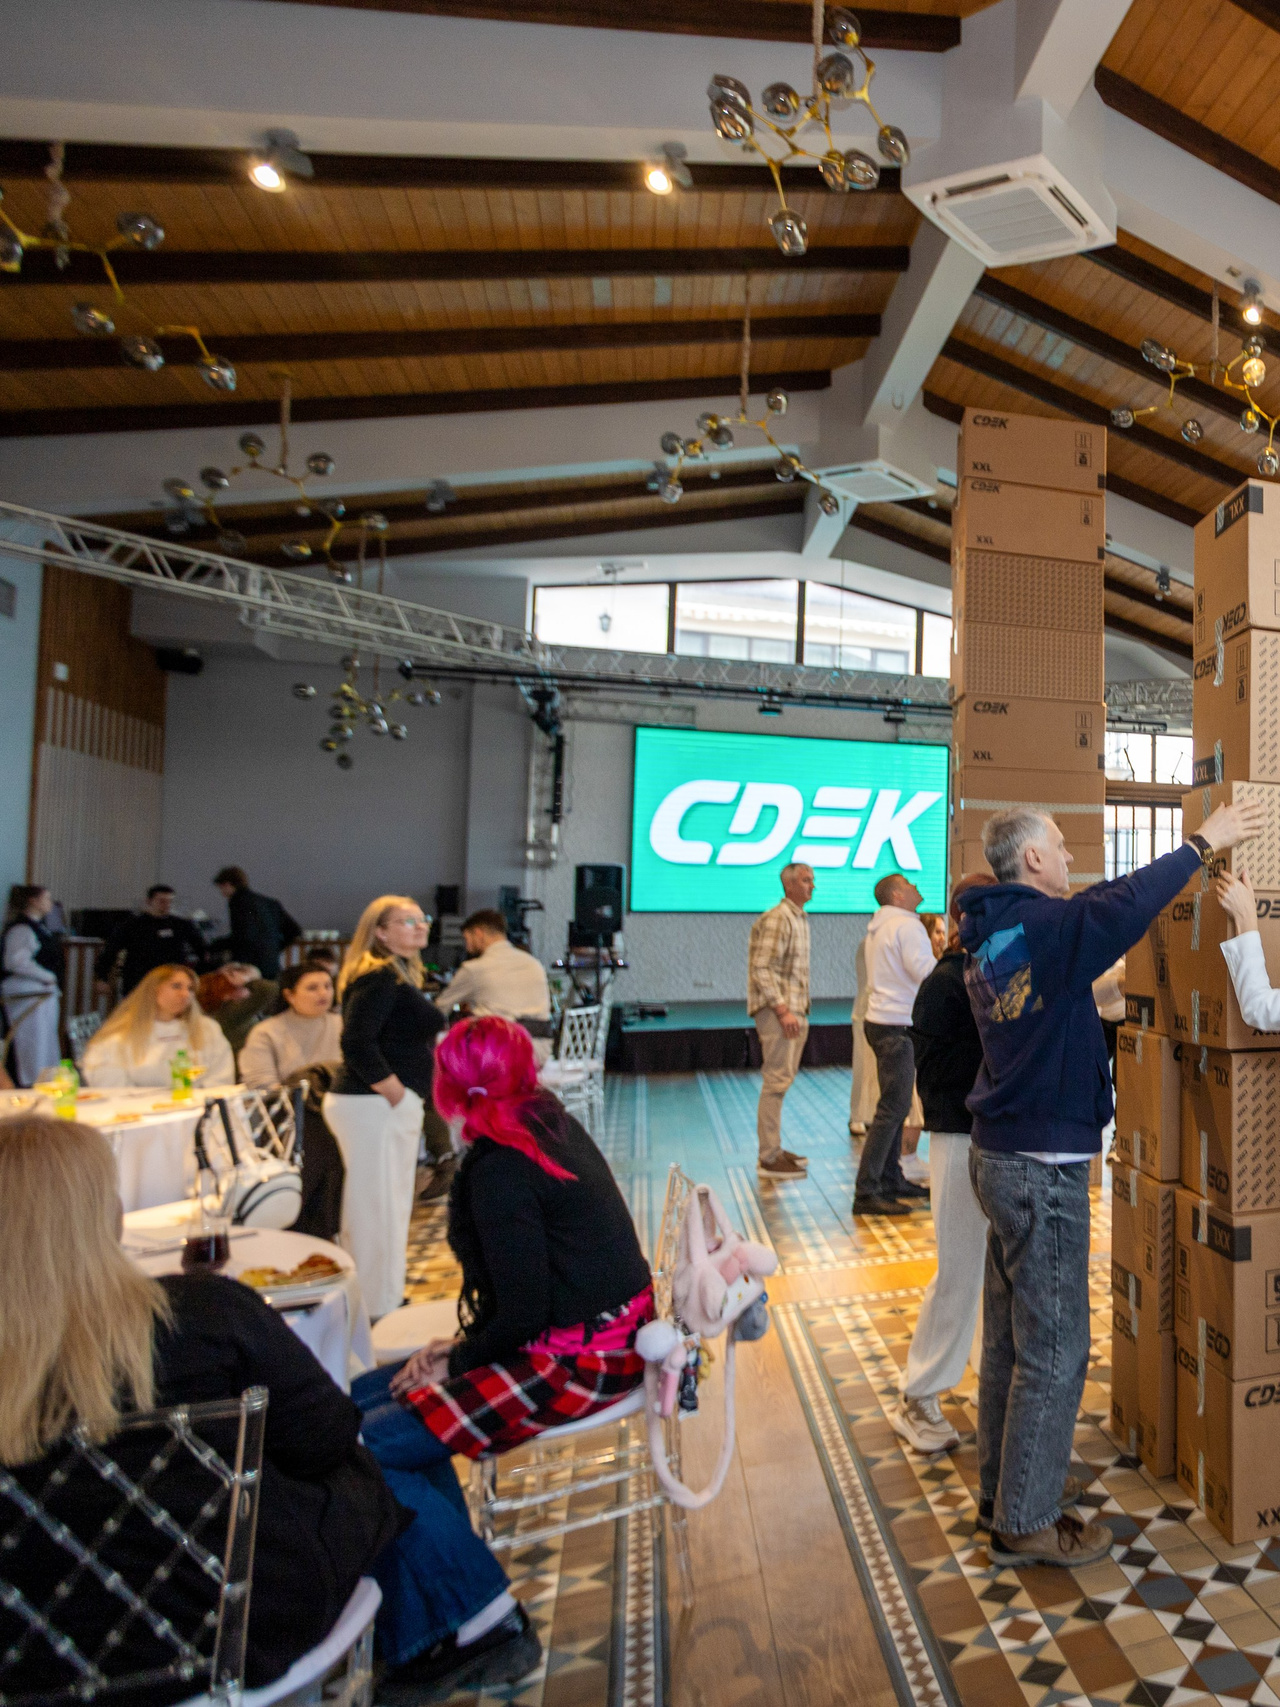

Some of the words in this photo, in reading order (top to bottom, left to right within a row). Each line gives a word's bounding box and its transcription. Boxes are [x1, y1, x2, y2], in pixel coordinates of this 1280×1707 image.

[972, 414, 1009, 429] CDEK
[972, 461, 992, 472] XXL
[1229, 496, 1245, 519] XXL
[976, 535, 994, 545] XXL
[1222, 601, 1247, 634] CDEK
[972, 701, 1009, 714] CDEK
[972, 751, 993, 761] XXL
[1193, 765, 1208, 782] XXL
[649, 779, 943, 871] CDEK
